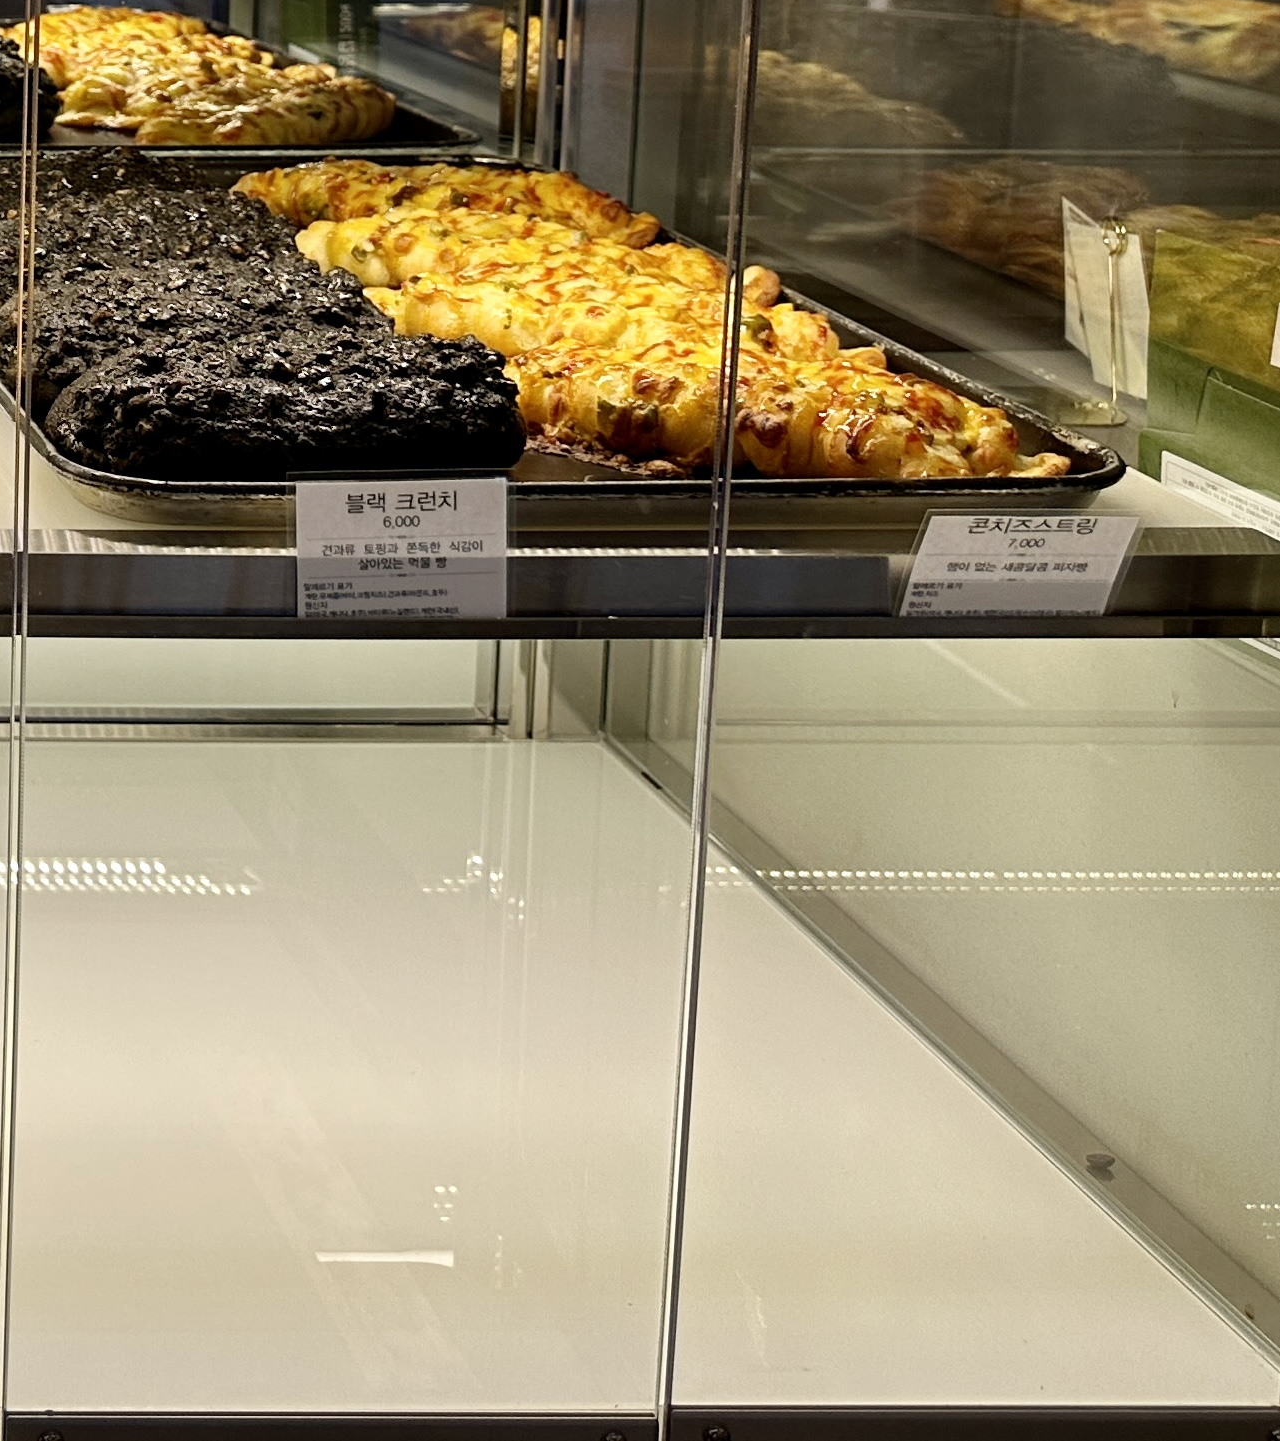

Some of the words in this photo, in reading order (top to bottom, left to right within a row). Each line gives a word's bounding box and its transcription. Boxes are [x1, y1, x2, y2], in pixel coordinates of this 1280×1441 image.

[345, 492, 386, 514] 블랙
[395, 490, 458, 511] 크런치
[383, 515, 420, 529] 6,000
[968, 517, 1098, 535] 콘치즈스트링
[322, 543, 356, 556] 견과류
[364, 542, 398, 555] 토핑과
[406, 541, 440, 554] 쫀득한
[449, 540, 483, 553] 식감이
[1007, 538, 1045, 549] 7,000
[358, 558, 404, 570] 살아있는
[408, 557, 431, 569] 먹물
[436, 557, 447, 569] 빵
[974, 562, 996, 572] 없는
[1001, 562, 1048, 572] 새콤달콤
[1053, 562, 1088, 572] 피자빵
